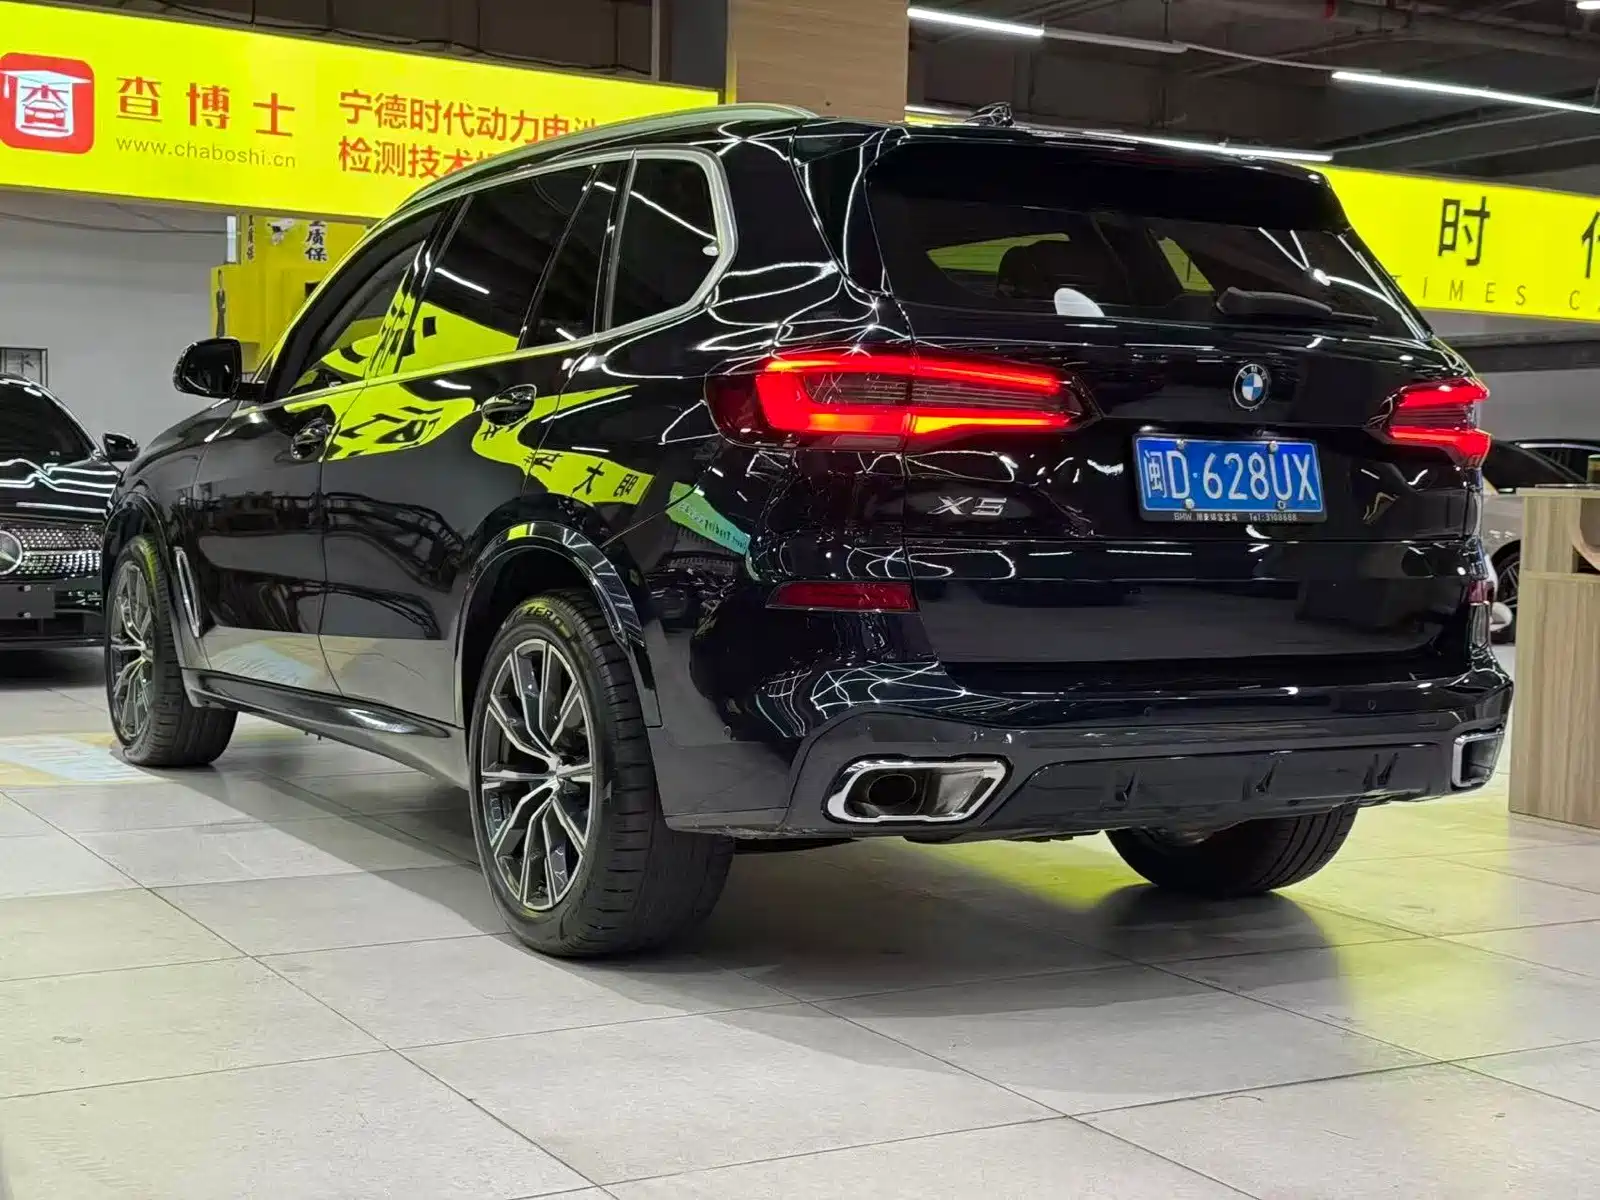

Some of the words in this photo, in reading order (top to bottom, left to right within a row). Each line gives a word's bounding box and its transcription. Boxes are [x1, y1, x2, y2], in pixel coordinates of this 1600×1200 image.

[116, 76, 296, 137] 查博士
[116, 136, 296, 168] www.chaboshi.cn
[338, 135, 493, 179] 检测技术
[926, 496, 1007, 515] X5
